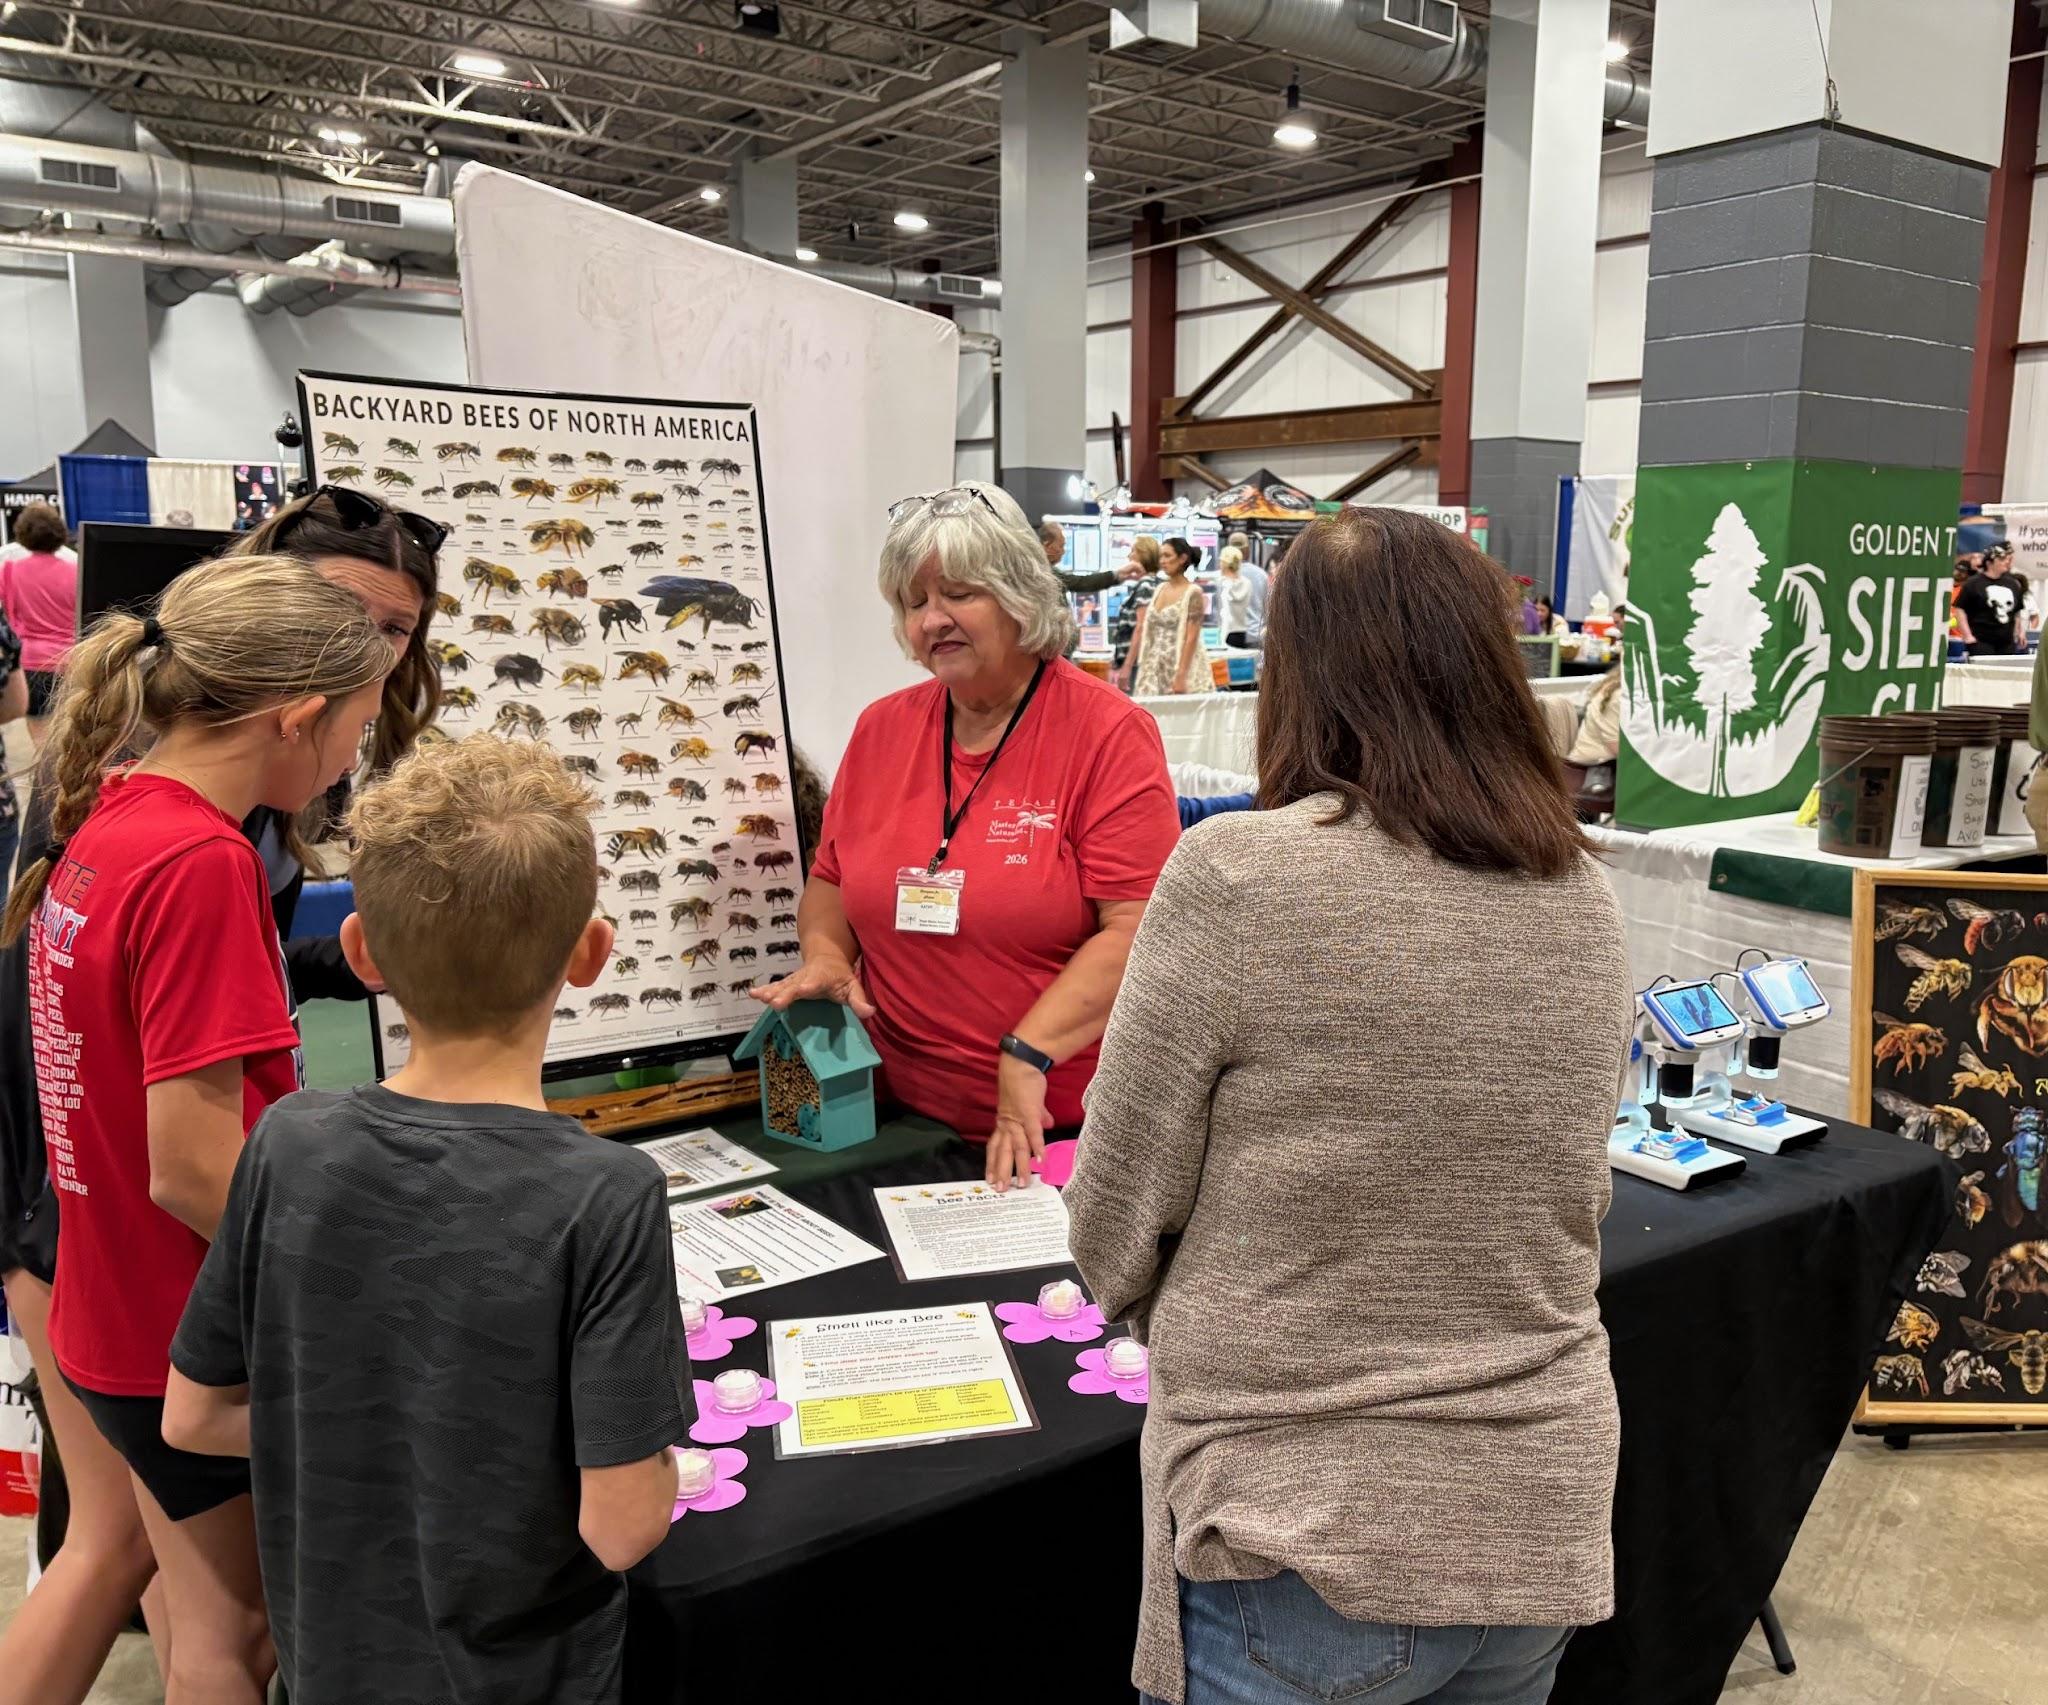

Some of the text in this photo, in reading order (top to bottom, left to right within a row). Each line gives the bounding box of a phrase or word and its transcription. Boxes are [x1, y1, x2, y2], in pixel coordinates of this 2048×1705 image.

[313, 392, 750, 443] BACKYARD BEES OF NORTH AMERICA
[1424, 513, 1462, 527] HOP
[1849, 522, 1957, 557] GOLDEN T
[1004, 853, 1028, 865] 2026
[937, 1193, 1006, 1205] Bee Facts
[866, 1317, 894, 1328] like
[899, 1316, 908, 1324] a
[912, 1313, 944, 1324] Bee
